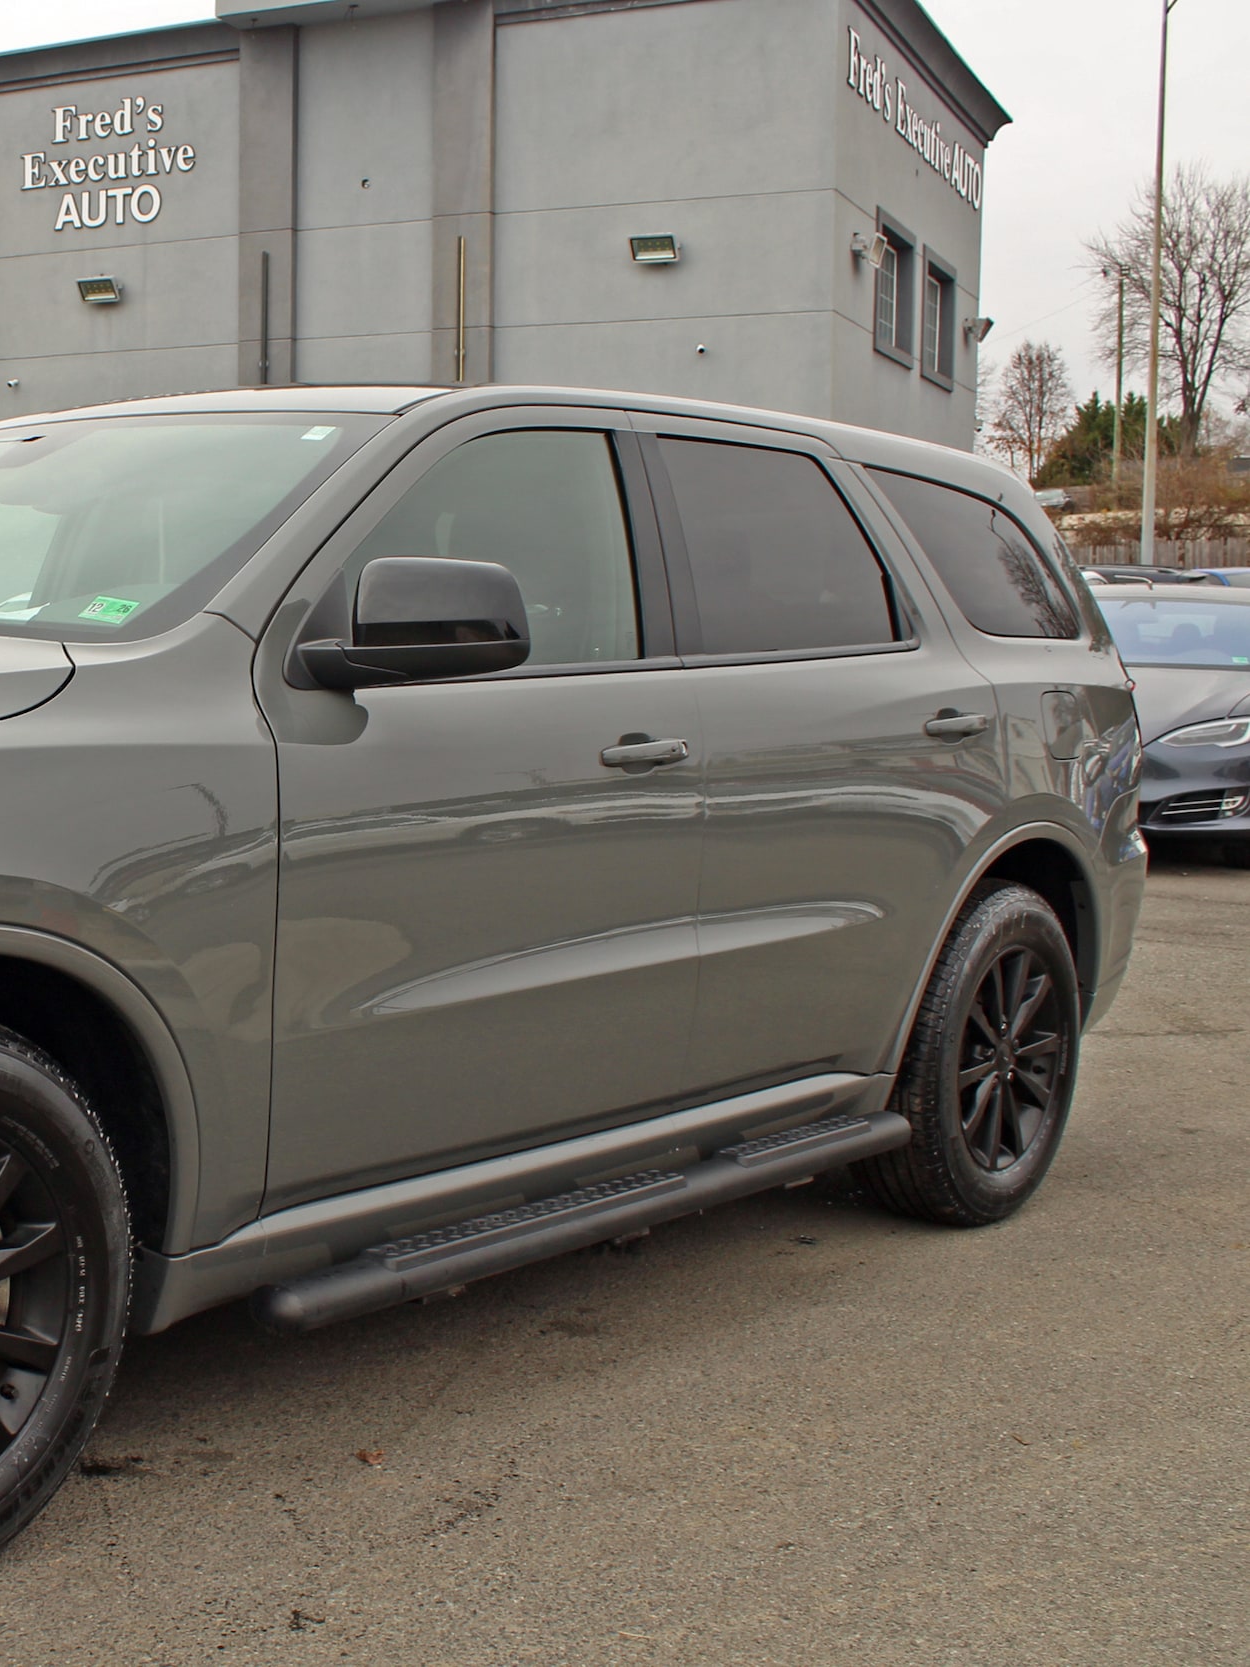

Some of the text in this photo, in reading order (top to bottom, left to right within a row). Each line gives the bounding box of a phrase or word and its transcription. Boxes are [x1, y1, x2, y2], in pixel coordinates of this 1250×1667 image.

[52, 96, 163, 144] Fred's
[847, 25, 982, 211] Fred's Executive AUTO
[21, 138, 195, 190] Executive
[54, 184, 161, 231] AUTO
[88, 602, 132, 614] 12 26
